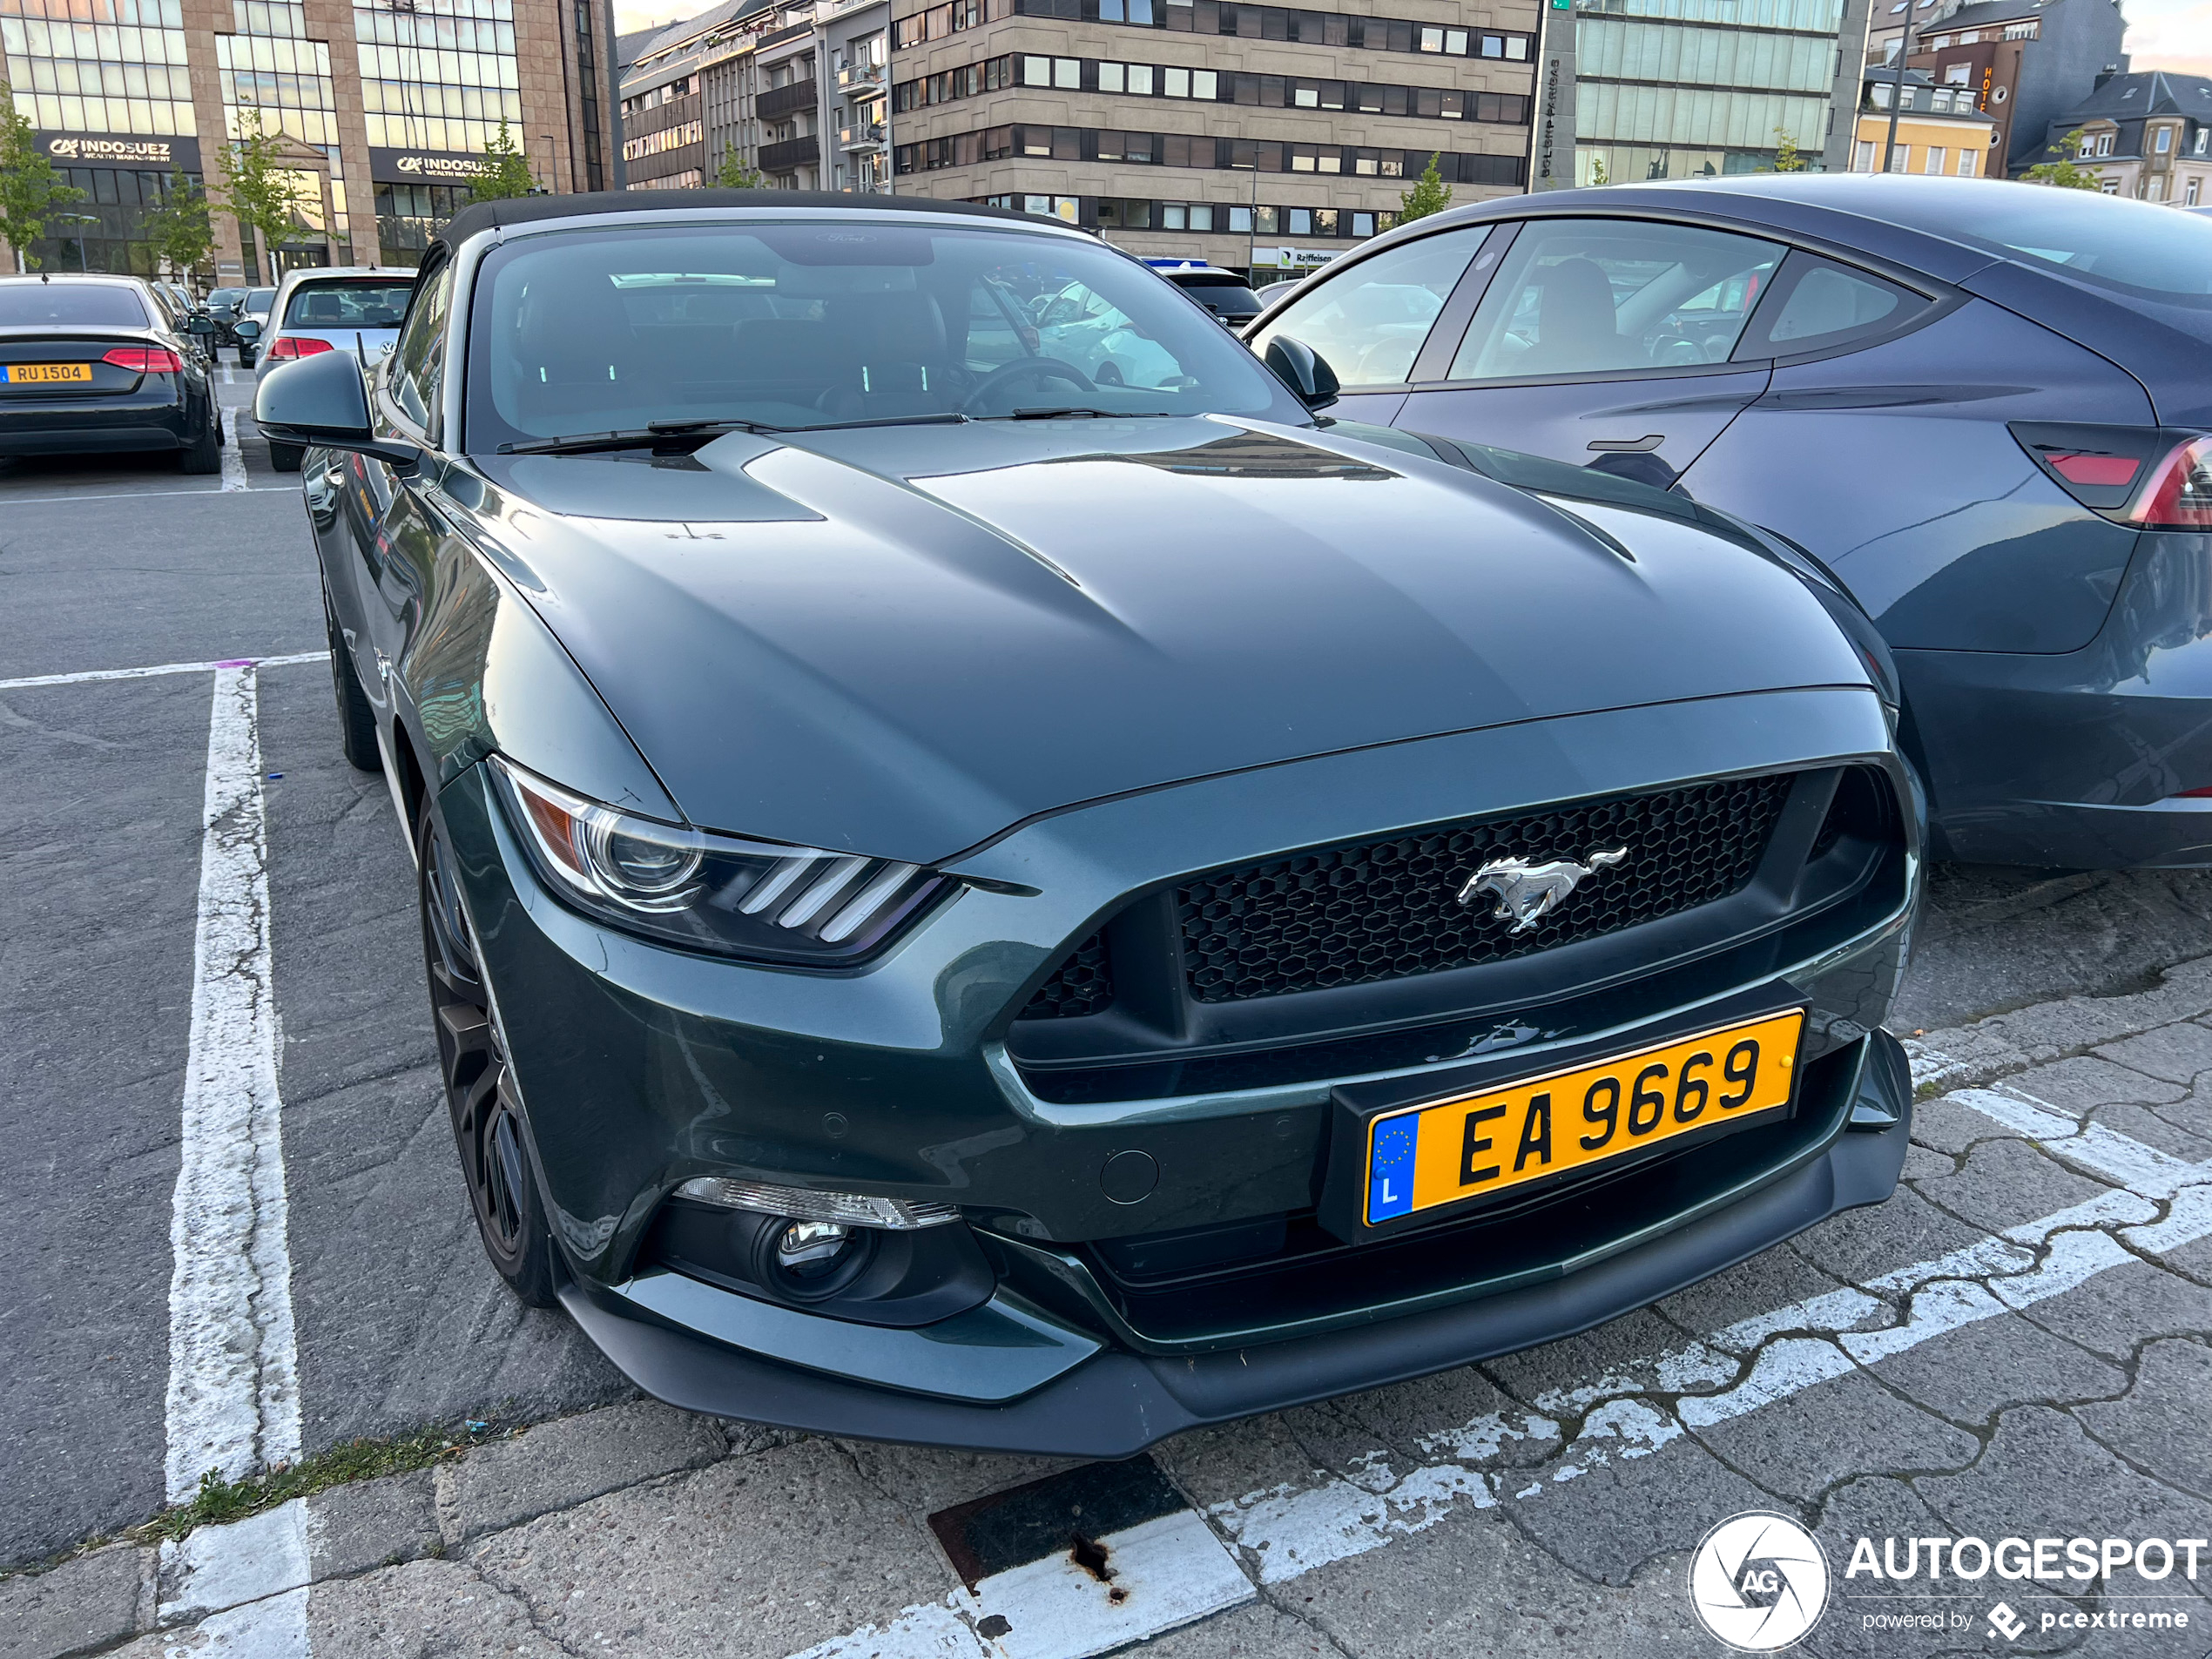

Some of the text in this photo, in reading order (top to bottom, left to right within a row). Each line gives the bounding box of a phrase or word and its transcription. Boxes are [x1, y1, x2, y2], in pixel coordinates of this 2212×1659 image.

[81, 139, 171, 156] INDOSUEZ
[1541, 59, 1560, 178] BGL BNP PARIBAS
[17, 367, 38, 381] RU
[42, 366, 82, 380] 1504
[1381, 1039, 1760, 1204] L EA 9669
